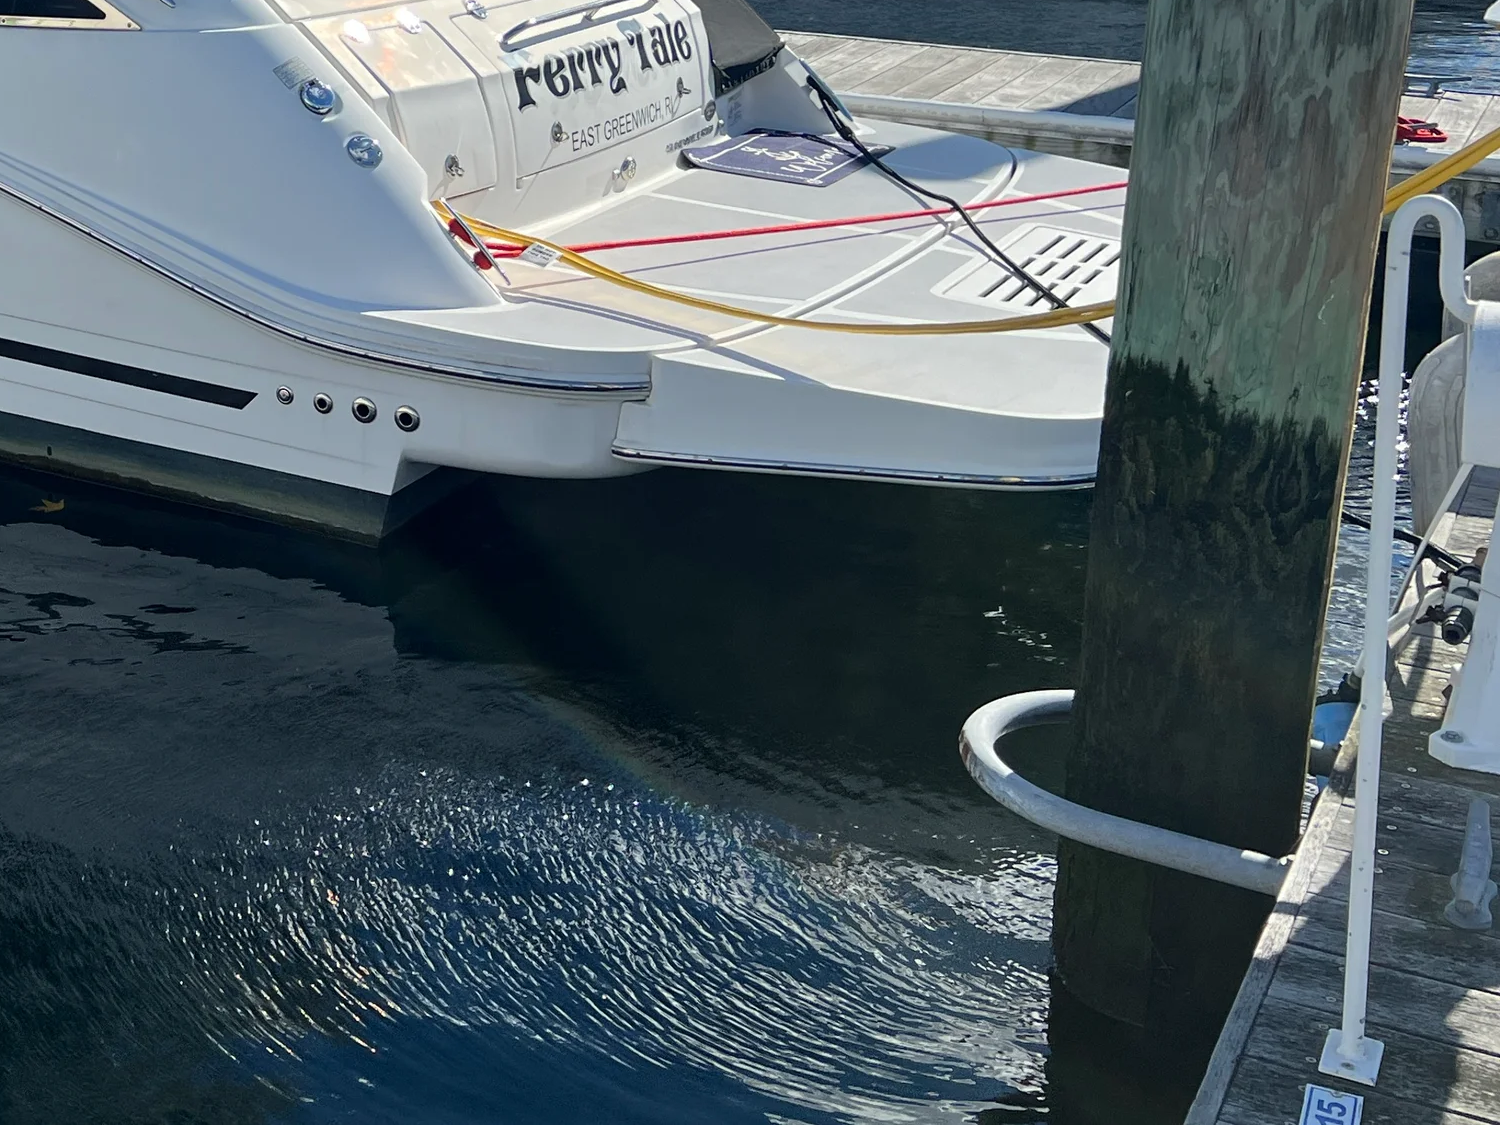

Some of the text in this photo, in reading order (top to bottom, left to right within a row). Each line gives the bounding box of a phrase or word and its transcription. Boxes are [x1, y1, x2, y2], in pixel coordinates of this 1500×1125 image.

[501, 13, 692, 112] Ferry Tale
[571, 123, 601, 152] EAST
[603, 100, 664, 141] GREENWICH,
